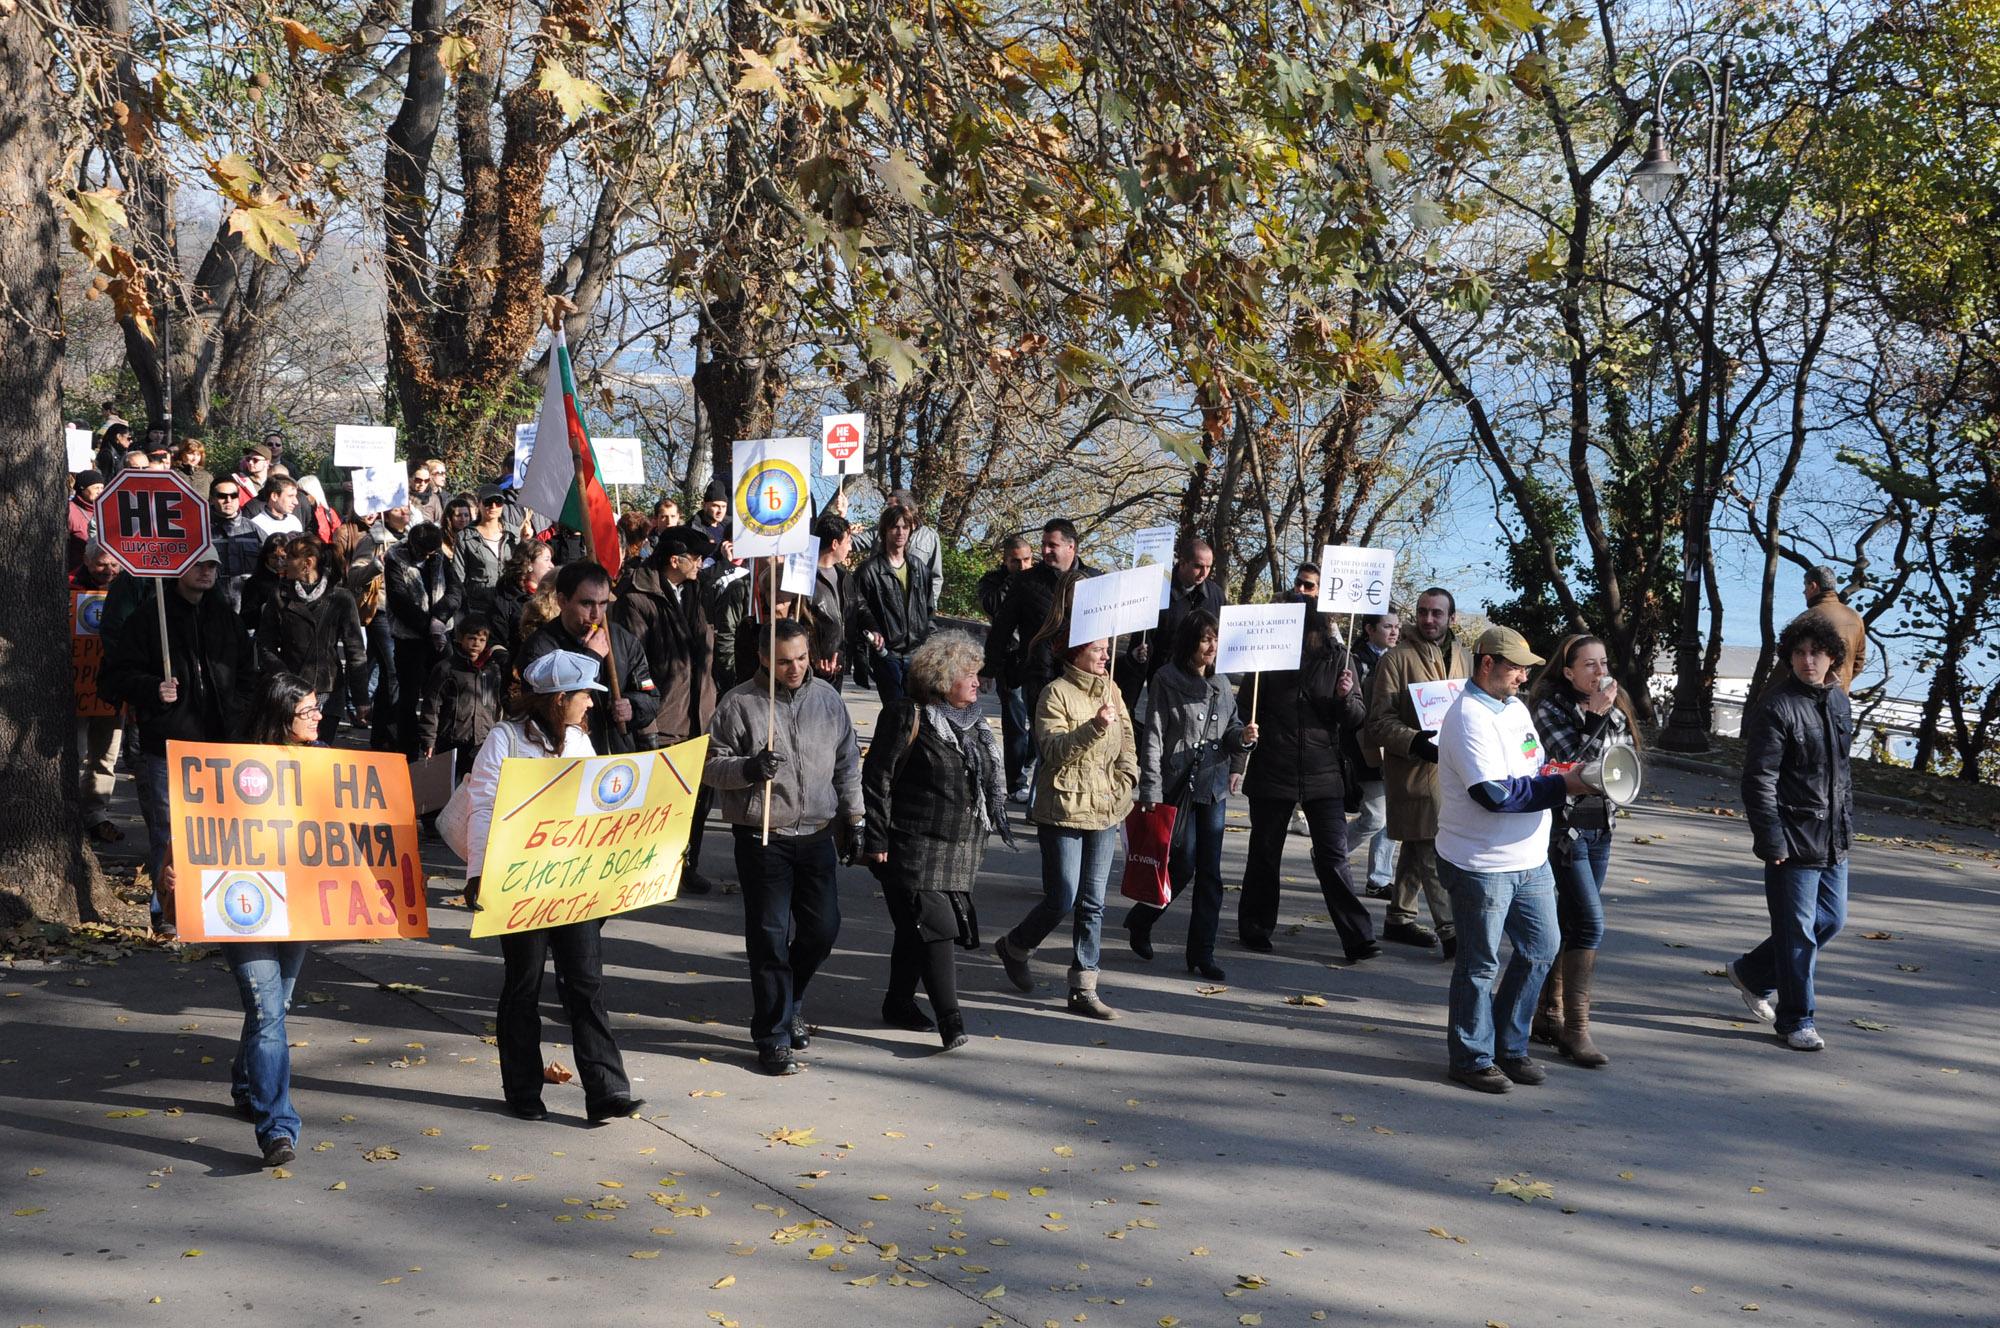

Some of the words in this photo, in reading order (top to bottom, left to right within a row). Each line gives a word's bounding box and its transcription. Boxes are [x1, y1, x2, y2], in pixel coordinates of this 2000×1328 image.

[836, 426, 849, 437] НЕ
[117, 490, 186, 538] НЕ
[121, 541, 189, 554] ШИСТОВ
[142, 554, 170, 567] ГАЗ
[1083, 604, 1113, 616] ВОДАТА
[181, 756, 303, 806] СТОП
[333, 763, 388, 810] НА
[185, 815, 398, 868] ШИСТОВИЯ
[501, 854, 593, 893] ЧИСТА
[599, 843, 657, 883] ВОДА
[506, 891, 600, 930] ЧИСТА
